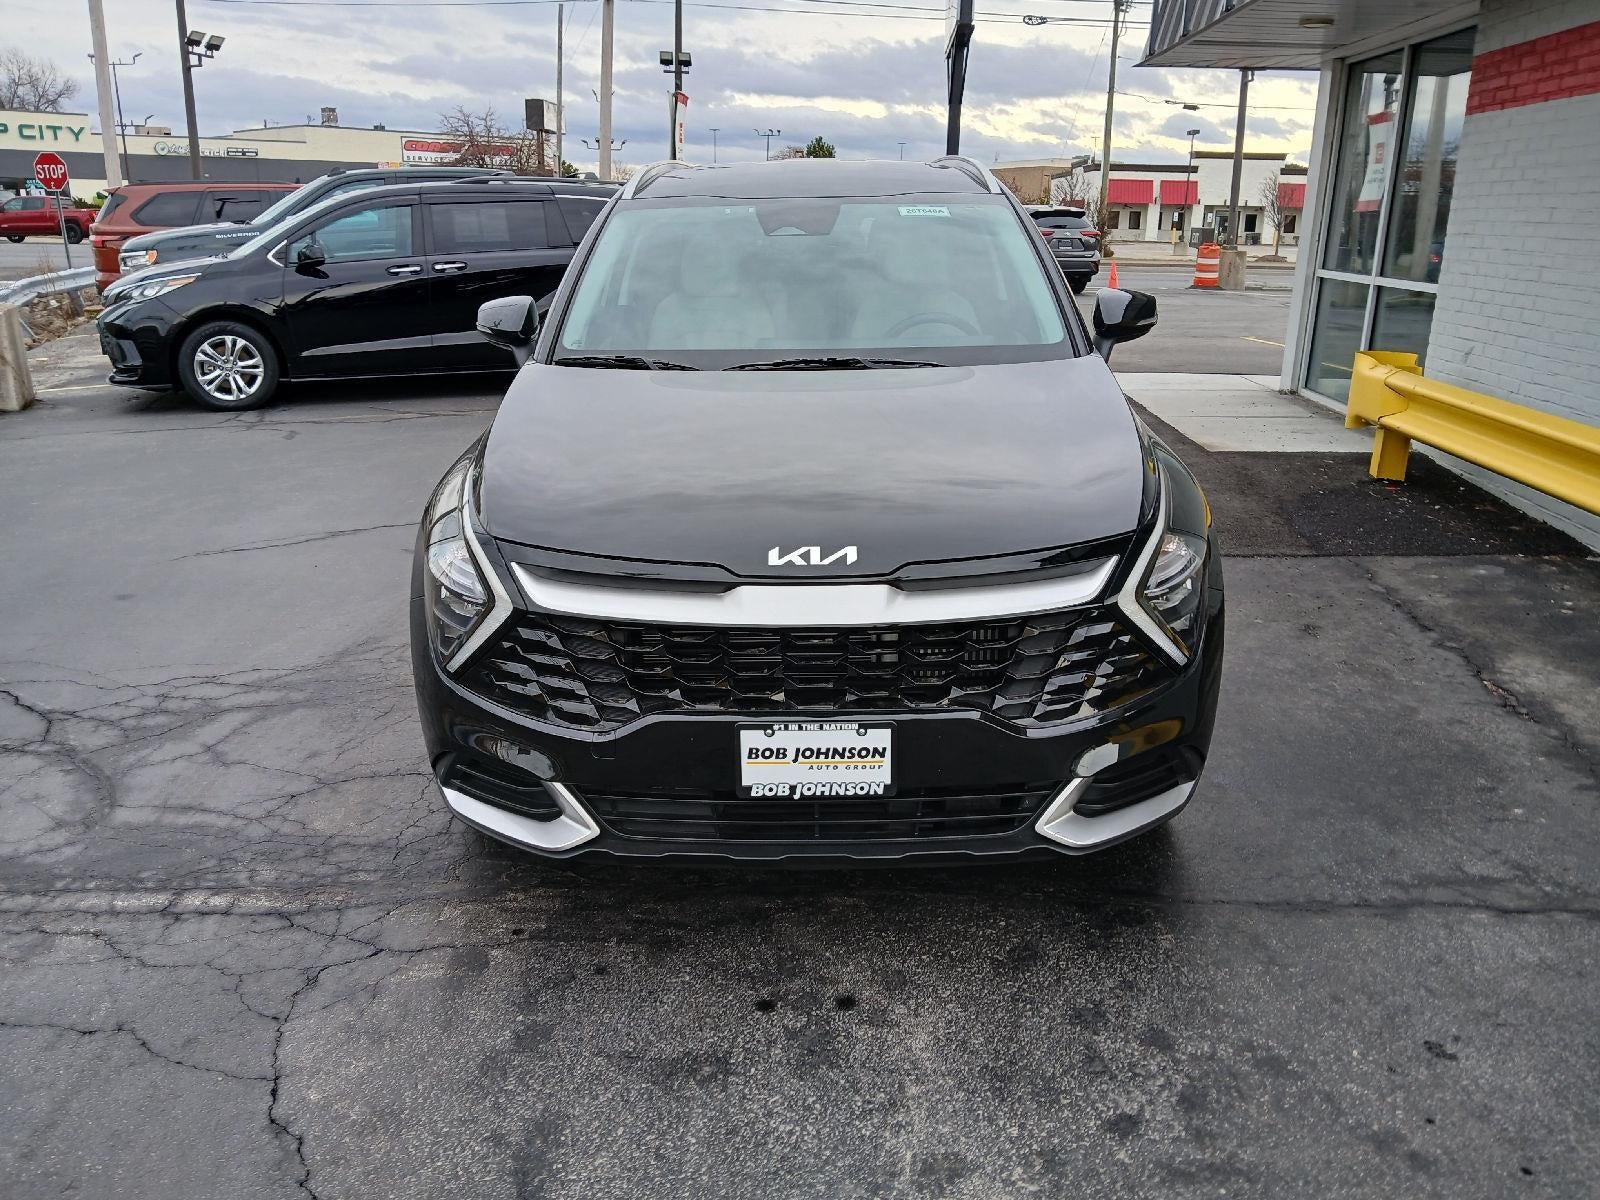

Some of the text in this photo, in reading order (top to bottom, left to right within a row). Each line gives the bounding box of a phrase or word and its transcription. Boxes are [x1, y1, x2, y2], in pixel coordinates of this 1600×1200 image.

[18, 124, 86, 141] CITY
[36, 164, 65, 179] STOP
[768, 546, 857, 565] KIA
[773, 723, 859, 731] #1 IN THE NATION
[747, 747, 887, 763] BOB JOHNSON
[750, 782, 885, 799] BOB JOHNSON
